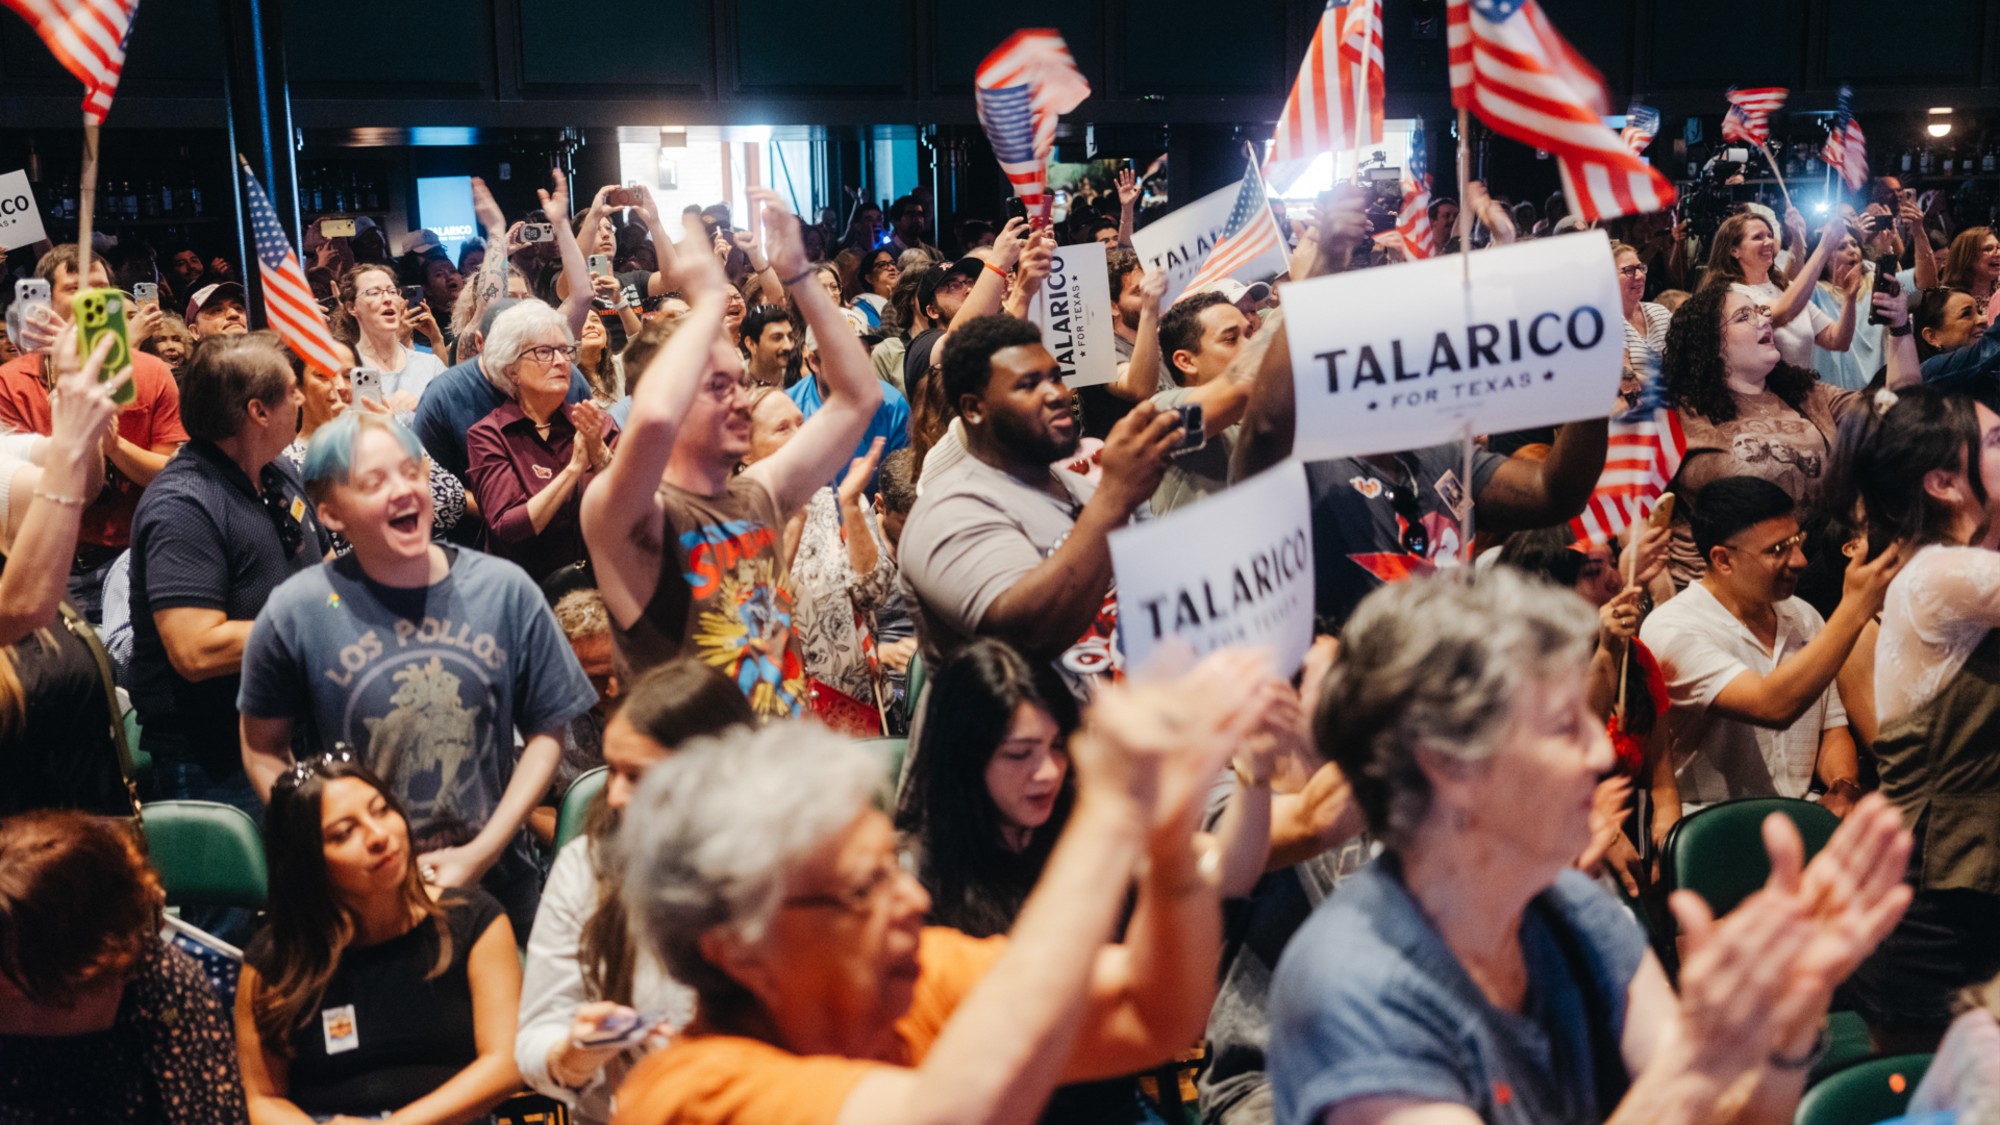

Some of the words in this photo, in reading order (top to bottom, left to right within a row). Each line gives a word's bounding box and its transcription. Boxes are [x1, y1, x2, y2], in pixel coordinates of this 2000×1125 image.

[0, 195, 29, 217] CO
[427, 225, 472, 236] ALARICO
[1072, 285, 1083, 320] TEXAS
[1077, 325, 1086, 347] FOR
[1314, 304, 1605, 394] TALARICO
[1391, 382, 1438, 409] FOR
[1451, 372, 1532, 399] TEXAS
[1140, 527, 1307, 640] TALARICO
[325, 630, 383, 687] LOS
[393, 616, 507, 670] POLLOS
